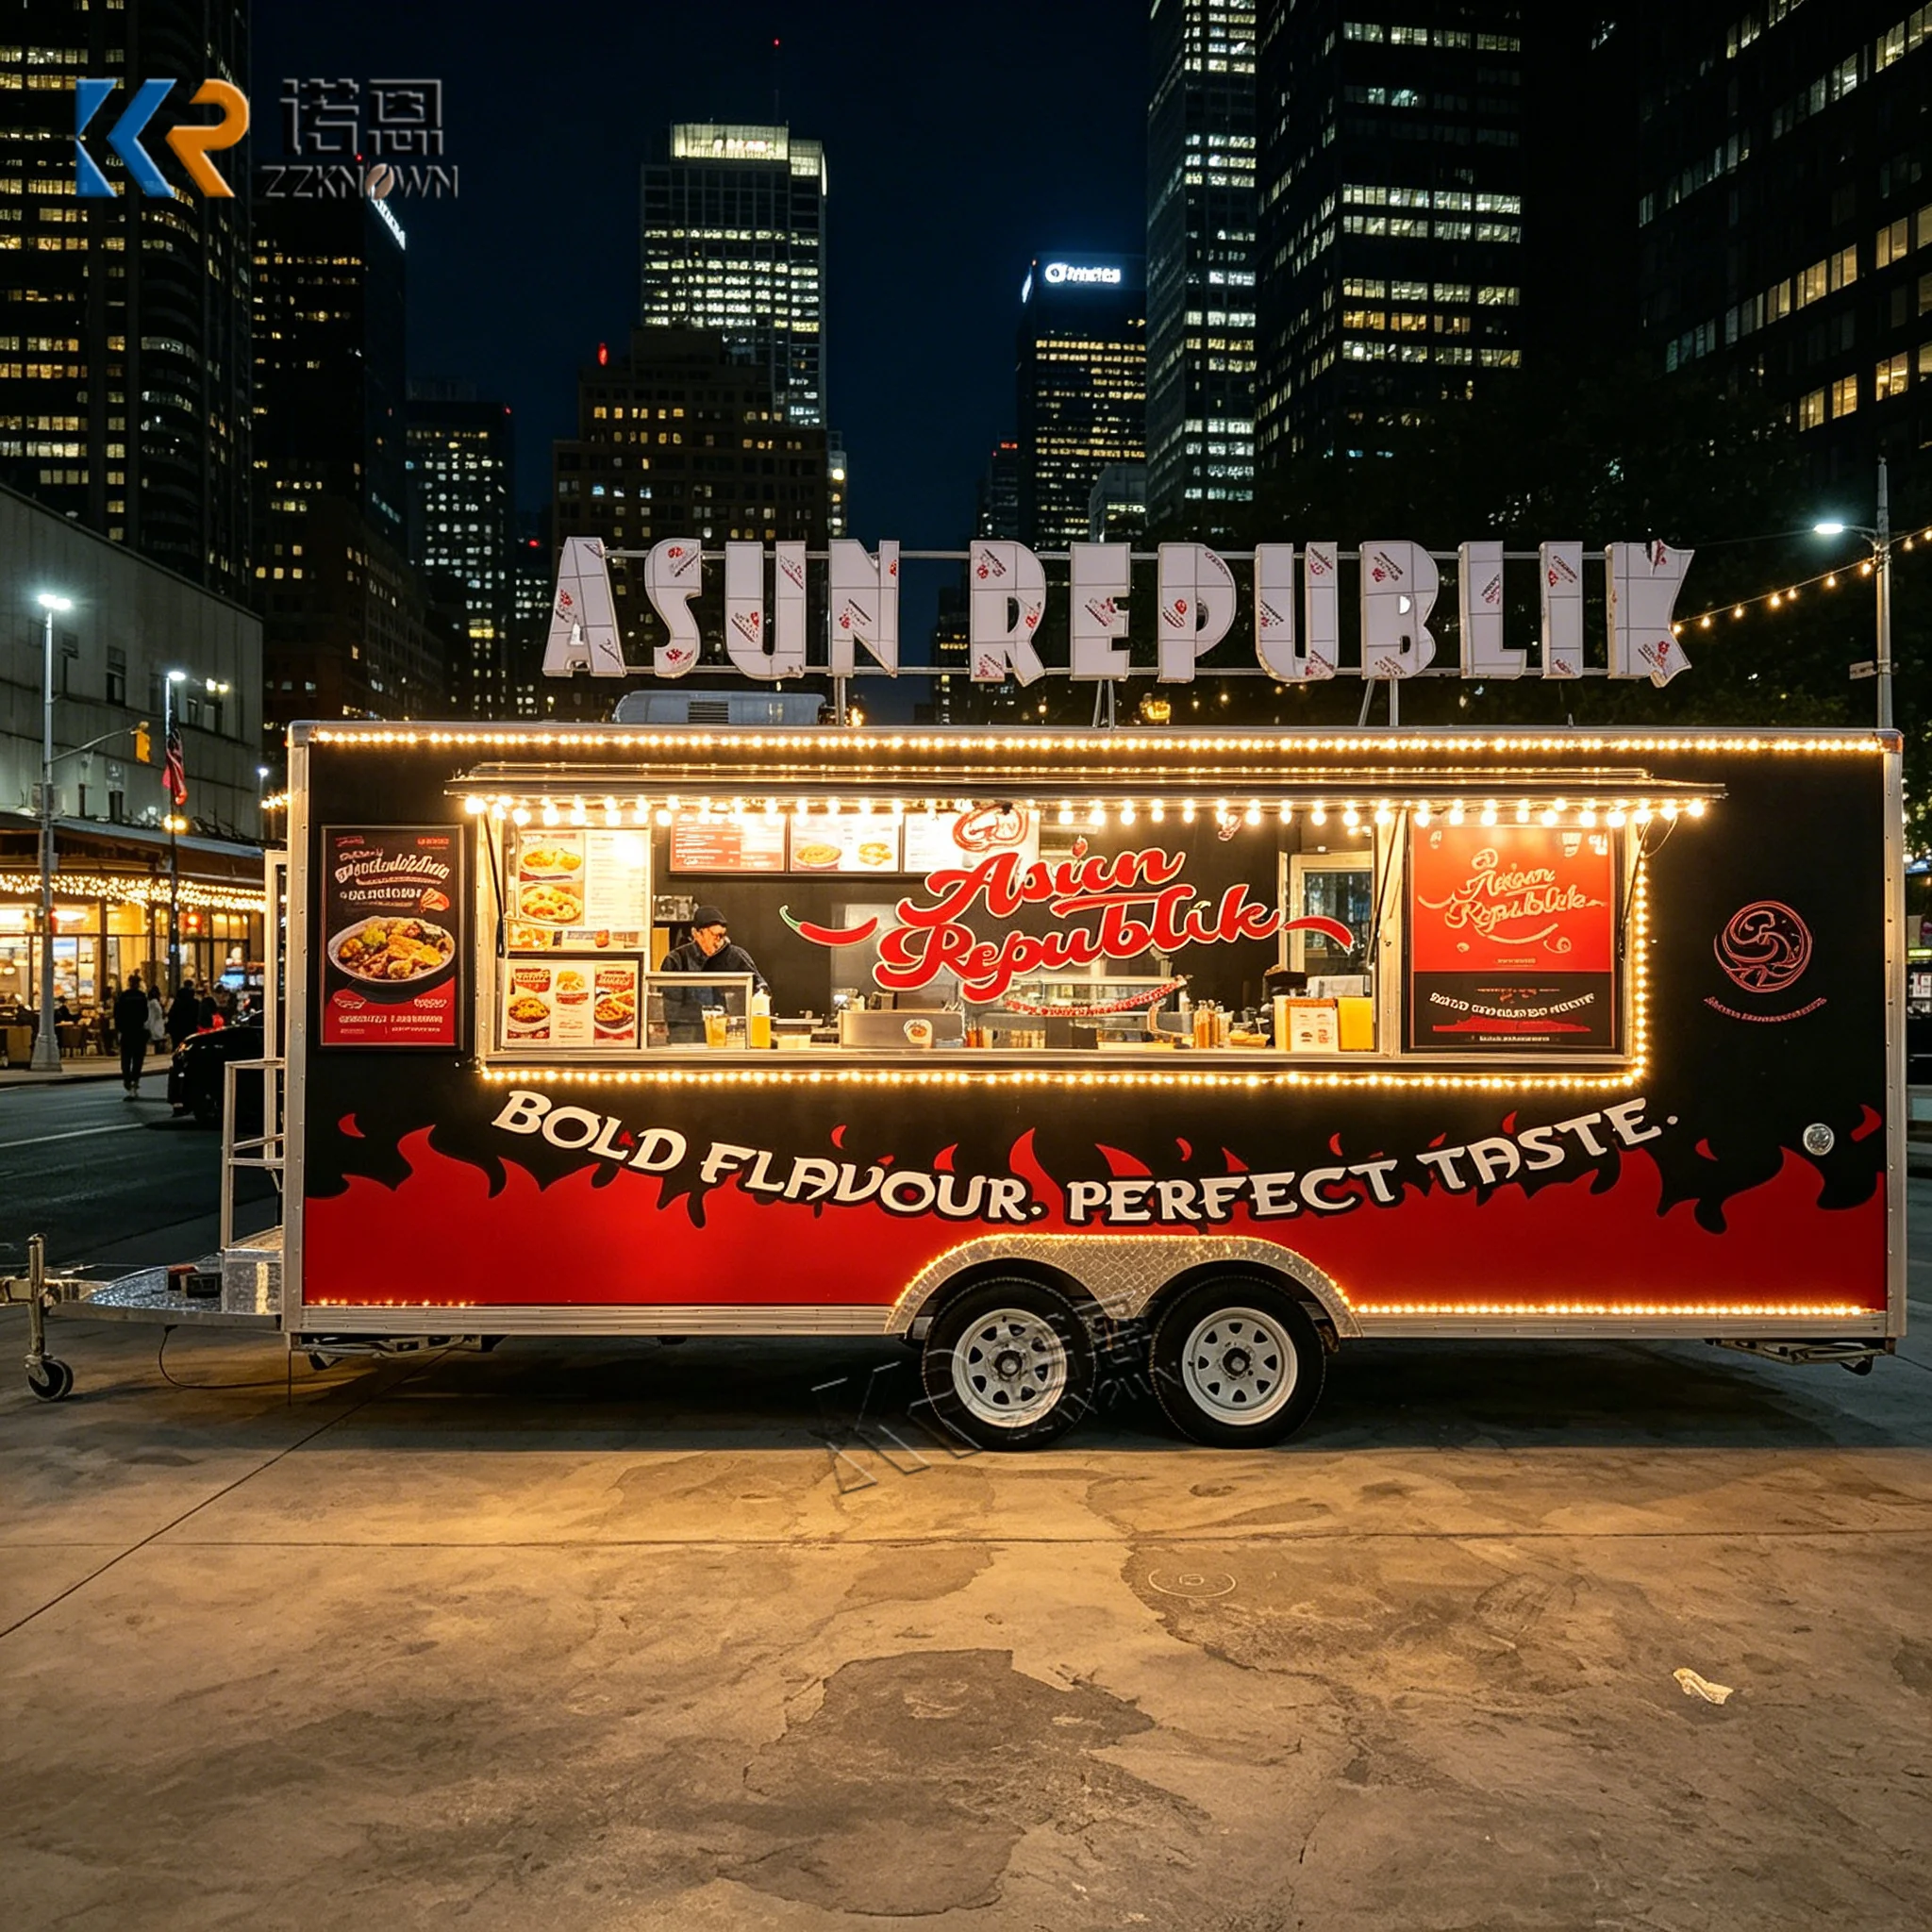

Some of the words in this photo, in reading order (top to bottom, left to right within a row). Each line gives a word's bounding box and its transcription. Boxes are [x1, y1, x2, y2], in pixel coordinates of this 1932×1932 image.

[873, 883, 1281, 1004] Republik
[491, 1090, 687, 1172] BOLD
[700, 1142, 1042, 1222] FLAVOUR.
[1067, 1159, 1398, 1223] PERFECT
[1416, 1097, 1679, 1191] TASTE.
